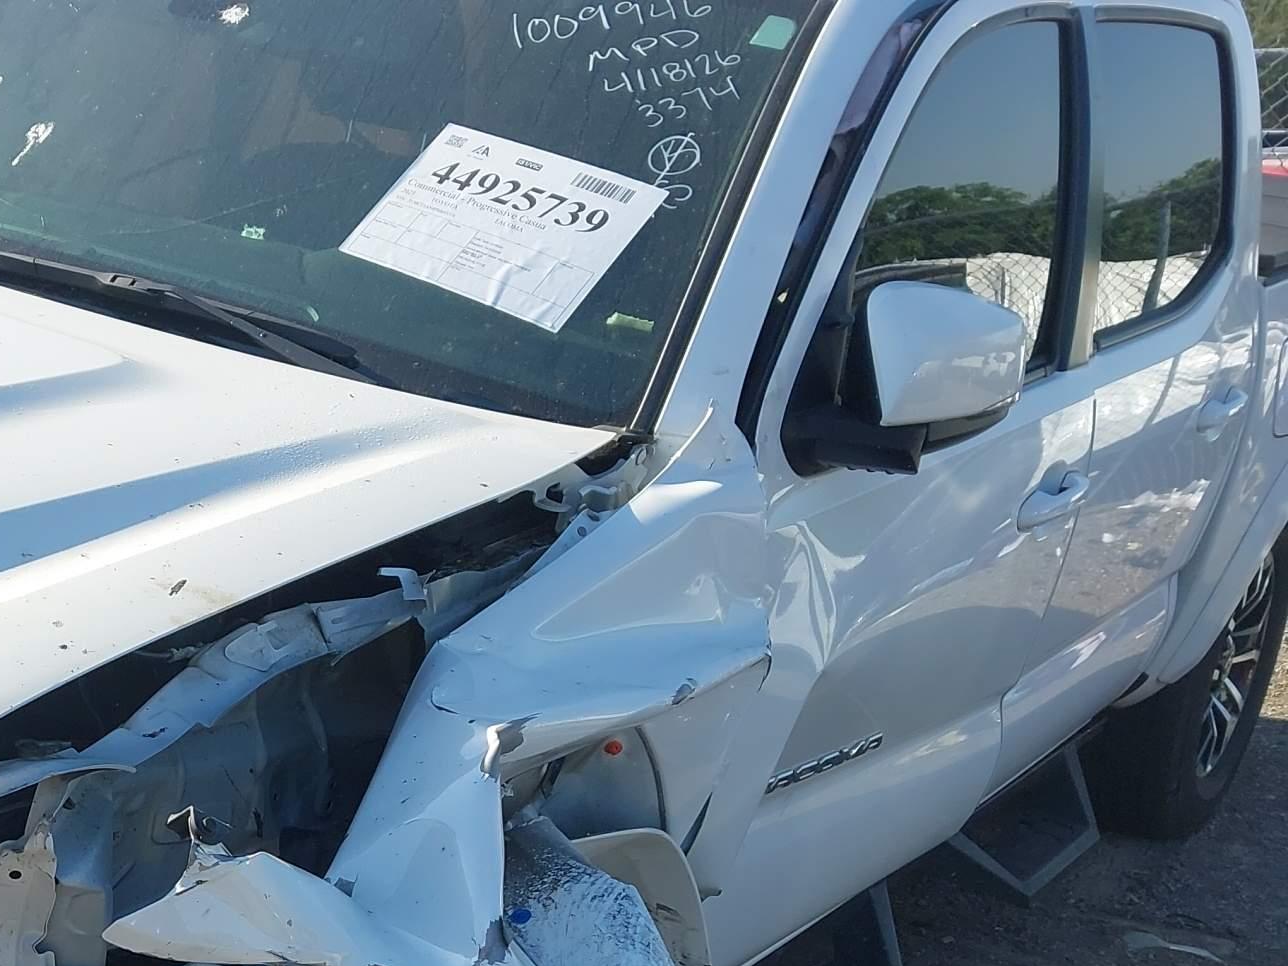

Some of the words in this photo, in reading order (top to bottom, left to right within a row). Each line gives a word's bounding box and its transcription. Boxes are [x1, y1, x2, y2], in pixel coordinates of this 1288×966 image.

[408, 177, 462, 201] Commercial
[466, 196, 517, 220] Progressive
[432, 162, 610, 234] 44925739
